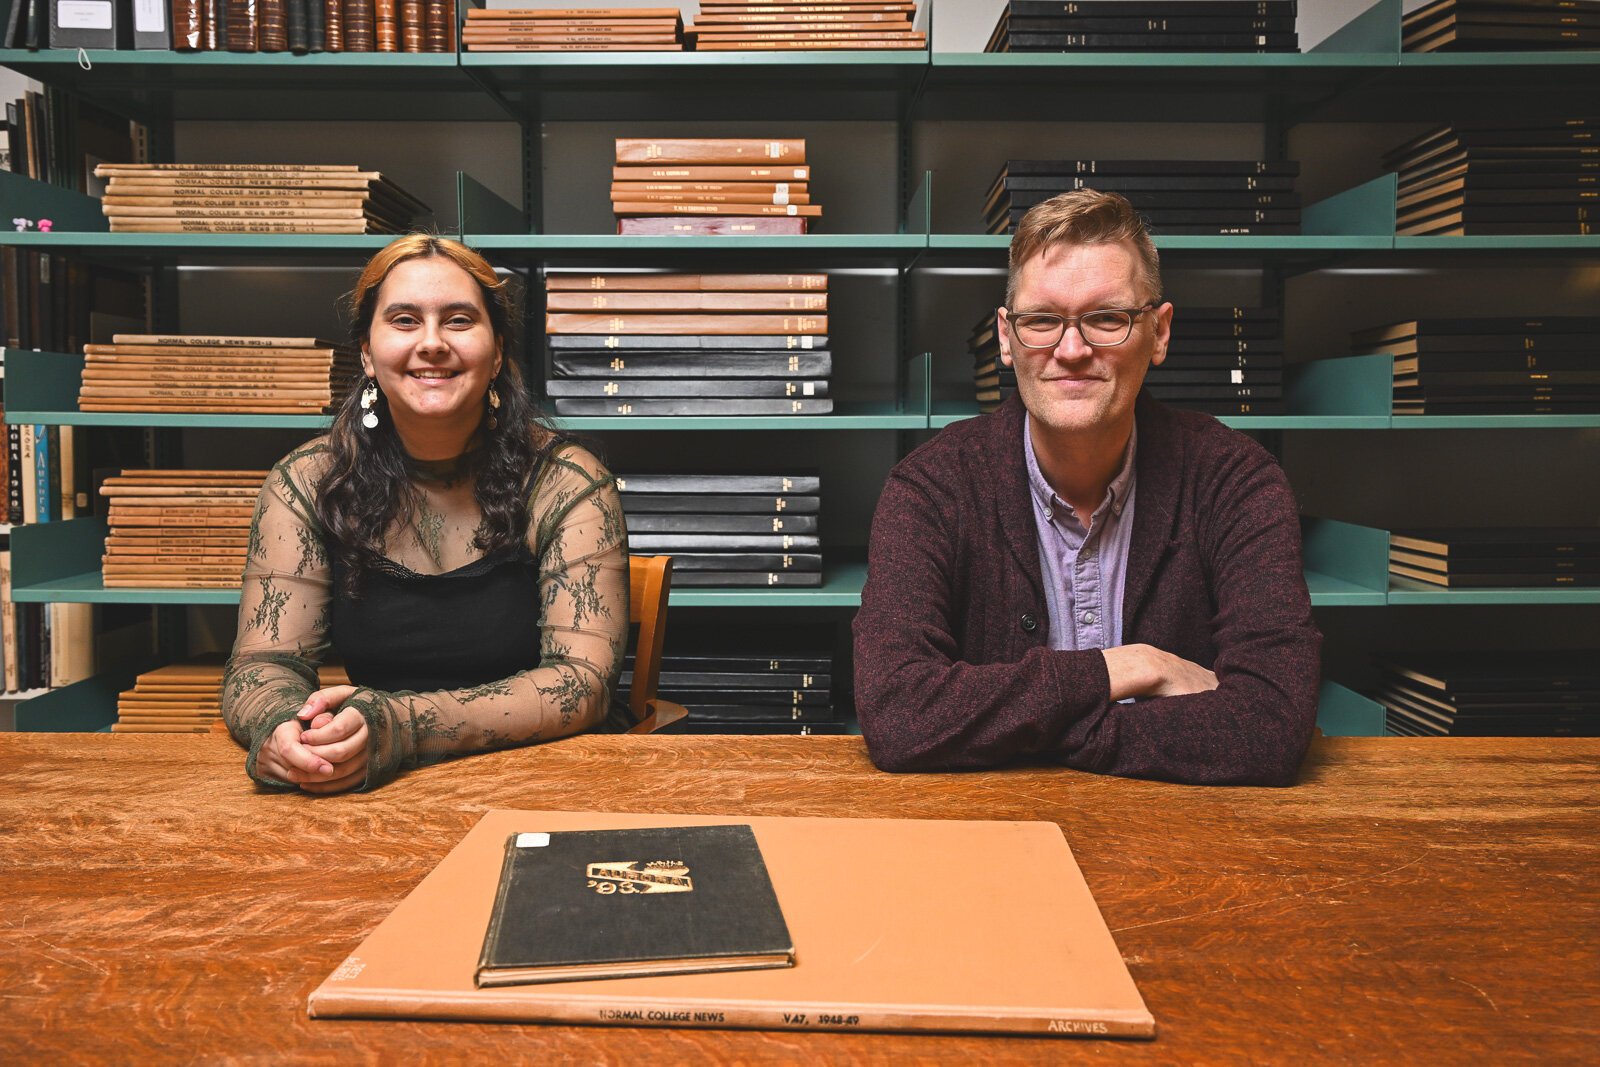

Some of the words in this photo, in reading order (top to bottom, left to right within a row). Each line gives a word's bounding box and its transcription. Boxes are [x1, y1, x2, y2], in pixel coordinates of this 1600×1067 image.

[11, 469, 19, 507] 1960
[598, 868, 684, 887] AURORA
[599, 1009, 644, 1020] NORMAL
[647, 1010, 691, 1022] COLLEGE
[694, 1012, 725, 1023] NEWS
[817, 1014, 859, 1026] 1948-49
[1047, 1019, 1109, 1034] ARCHIVES
